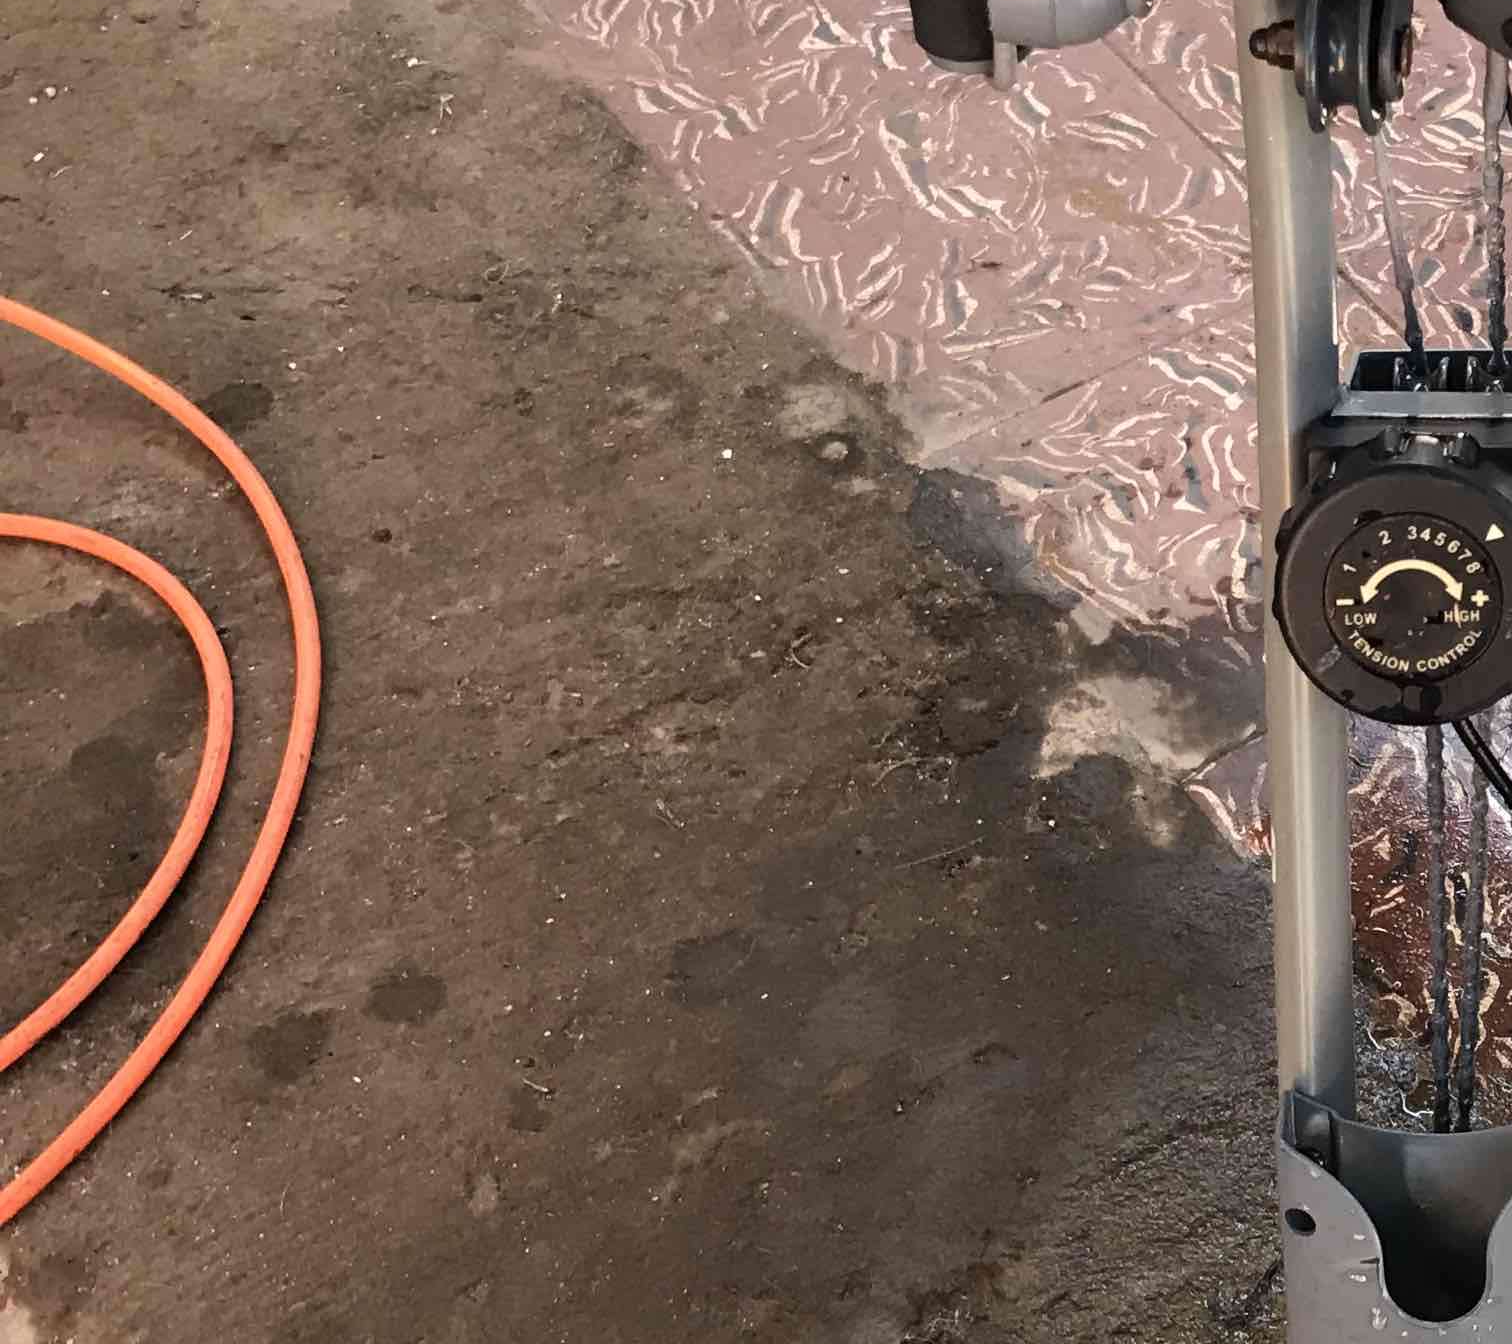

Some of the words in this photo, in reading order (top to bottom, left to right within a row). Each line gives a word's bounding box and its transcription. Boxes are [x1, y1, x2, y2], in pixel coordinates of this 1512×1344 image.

[1344, 613, 1377, 626] LOW
[1443, 610, 1481, 624] HIGH
[1347, 630, 1411, 673] TENSION
[1415, 628, 1483, 673] CONTROL
